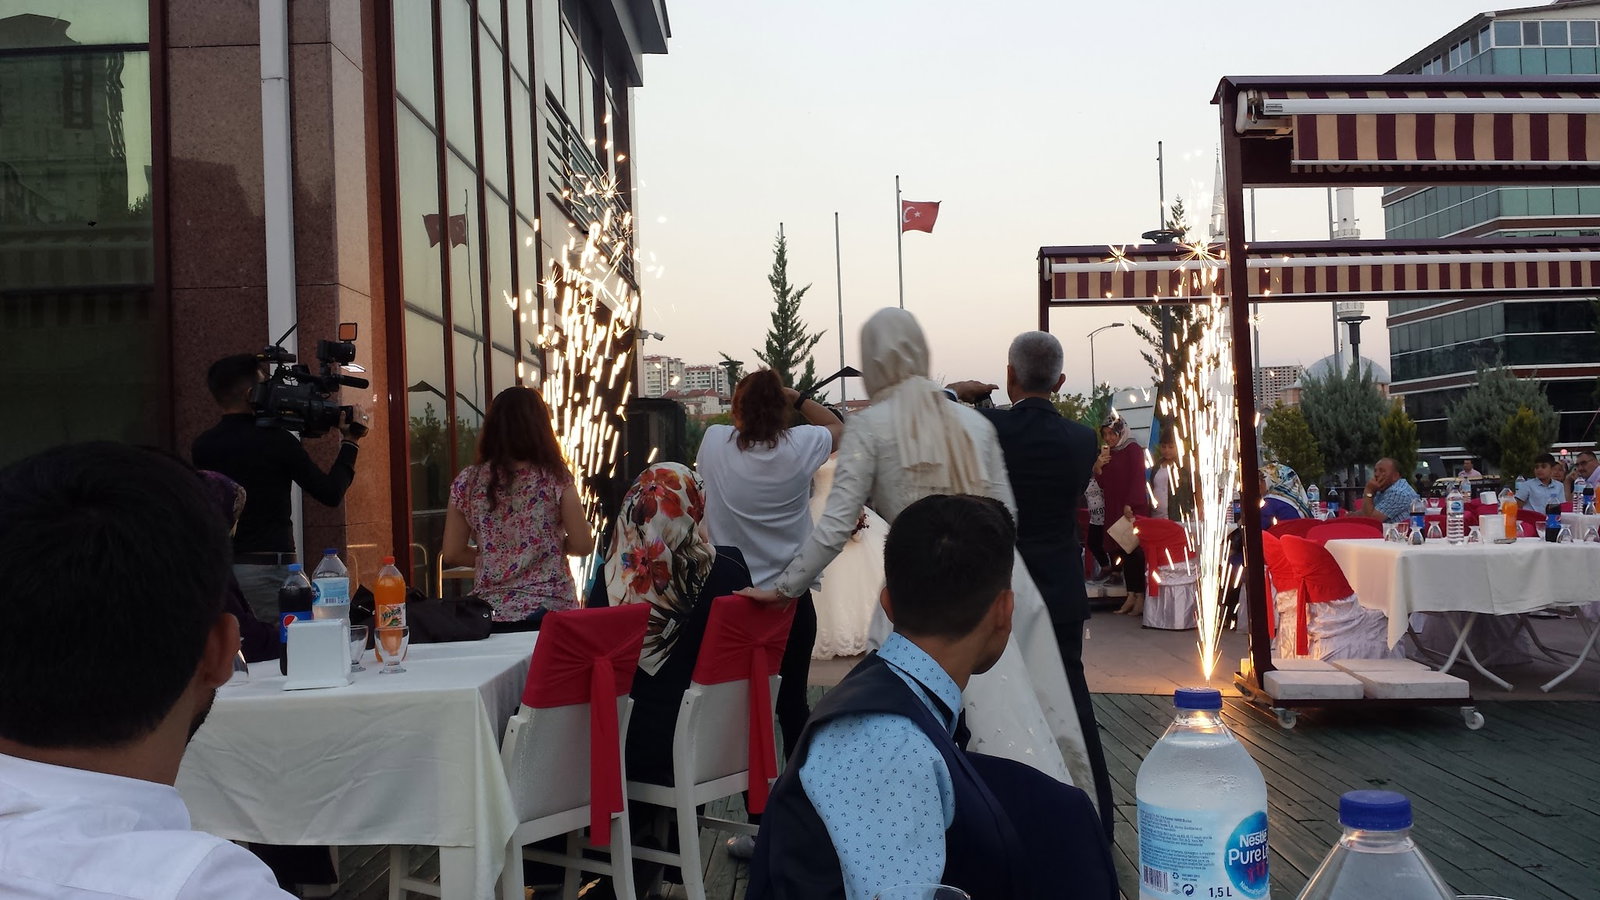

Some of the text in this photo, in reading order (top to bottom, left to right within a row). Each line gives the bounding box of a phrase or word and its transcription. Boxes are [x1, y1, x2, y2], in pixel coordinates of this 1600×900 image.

[1228, 848, 1262, 866] Pure
[1208, 887, 1224, 899] 1,5
[1226, 886, 1232, 897] L
